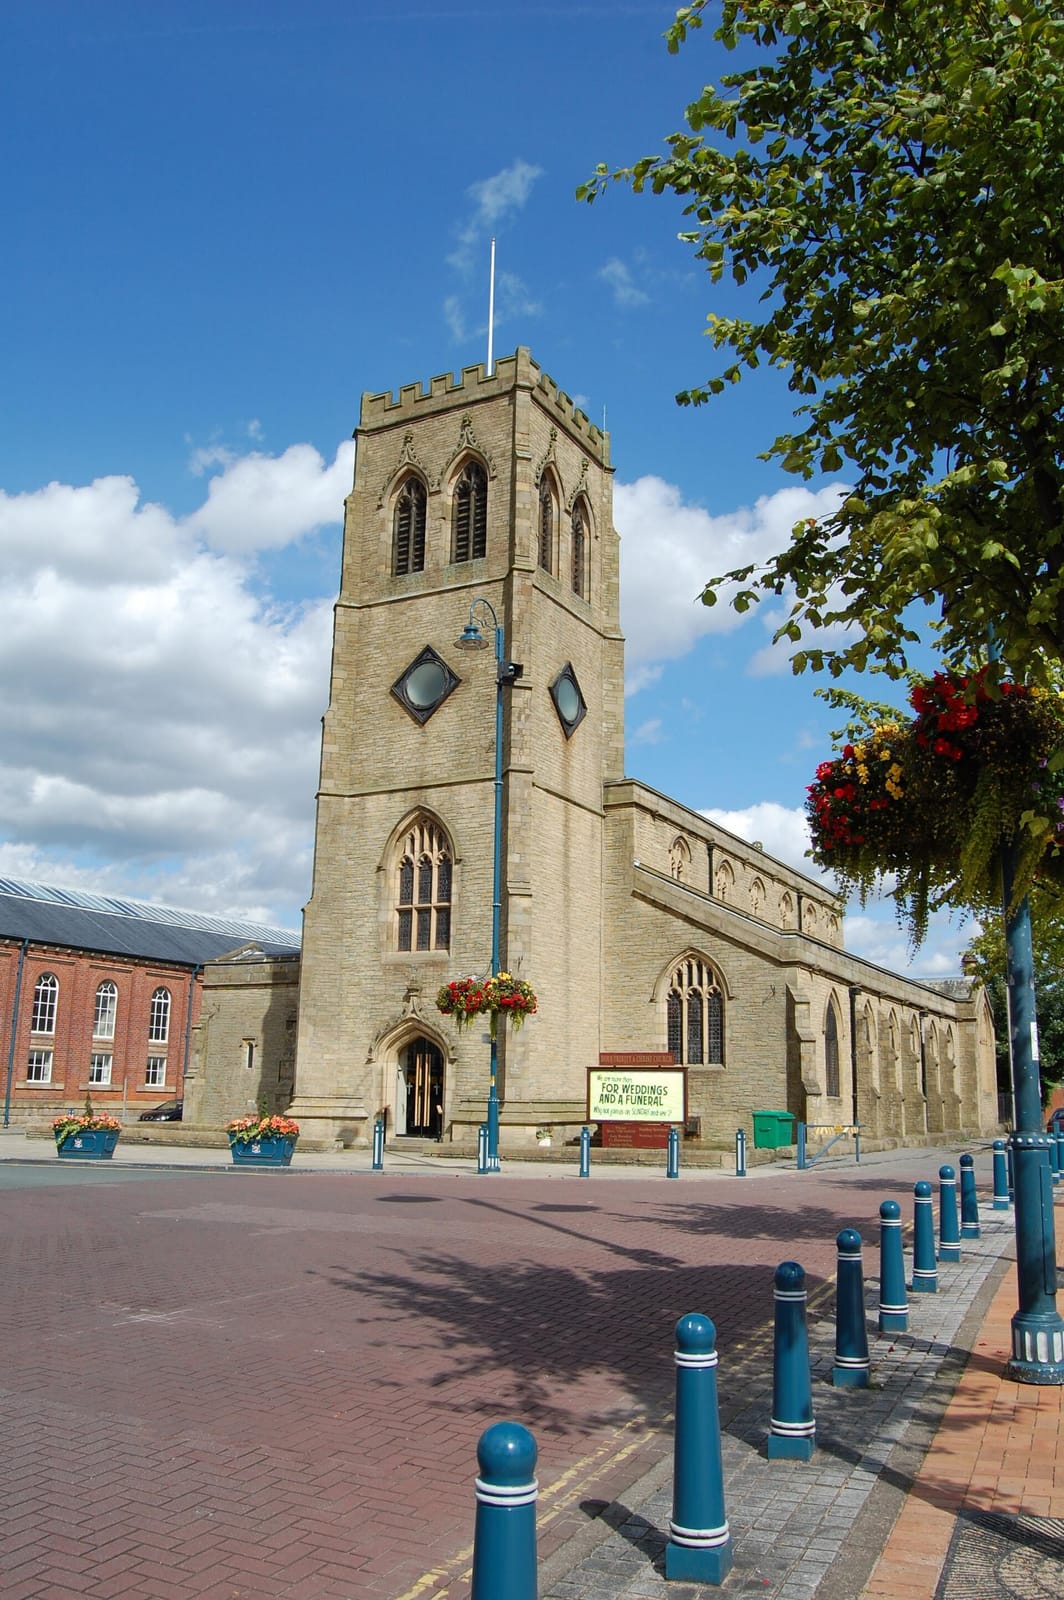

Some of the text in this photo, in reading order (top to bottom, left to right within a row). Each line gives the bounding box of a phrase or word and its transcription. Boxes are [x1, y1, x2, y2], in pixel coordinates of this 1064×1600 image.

[601, 1083, 668, 1096] FOR WEDDINGS
[598, 1094, 664, 1107] AND A FUNERAL
